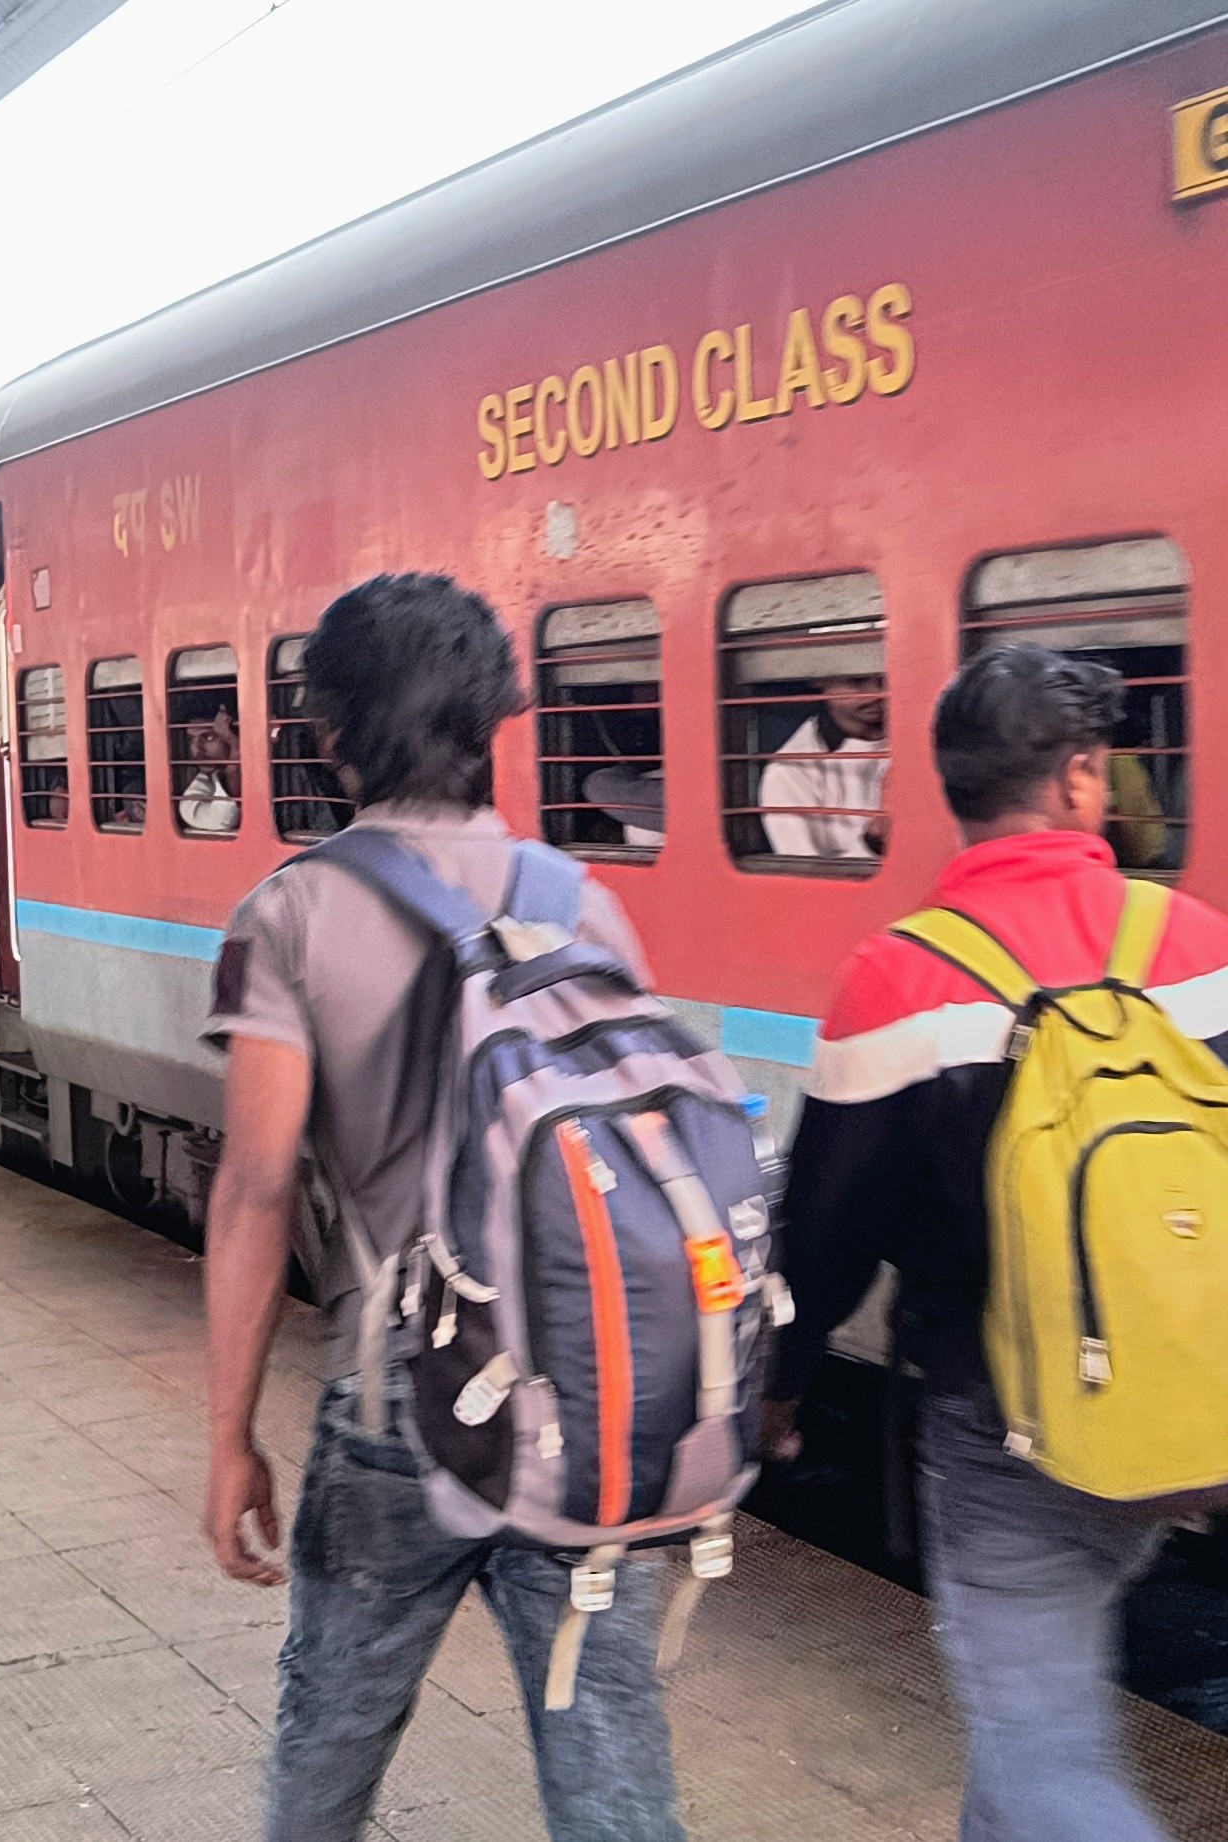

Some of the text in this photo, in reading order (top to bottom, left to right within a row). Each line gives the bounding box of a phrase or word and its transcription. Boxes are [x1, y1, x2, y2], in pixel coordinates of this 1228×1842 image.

[477, 282, 915, 480] SECOND CLASS
[160, 473, 201, 551] SW
